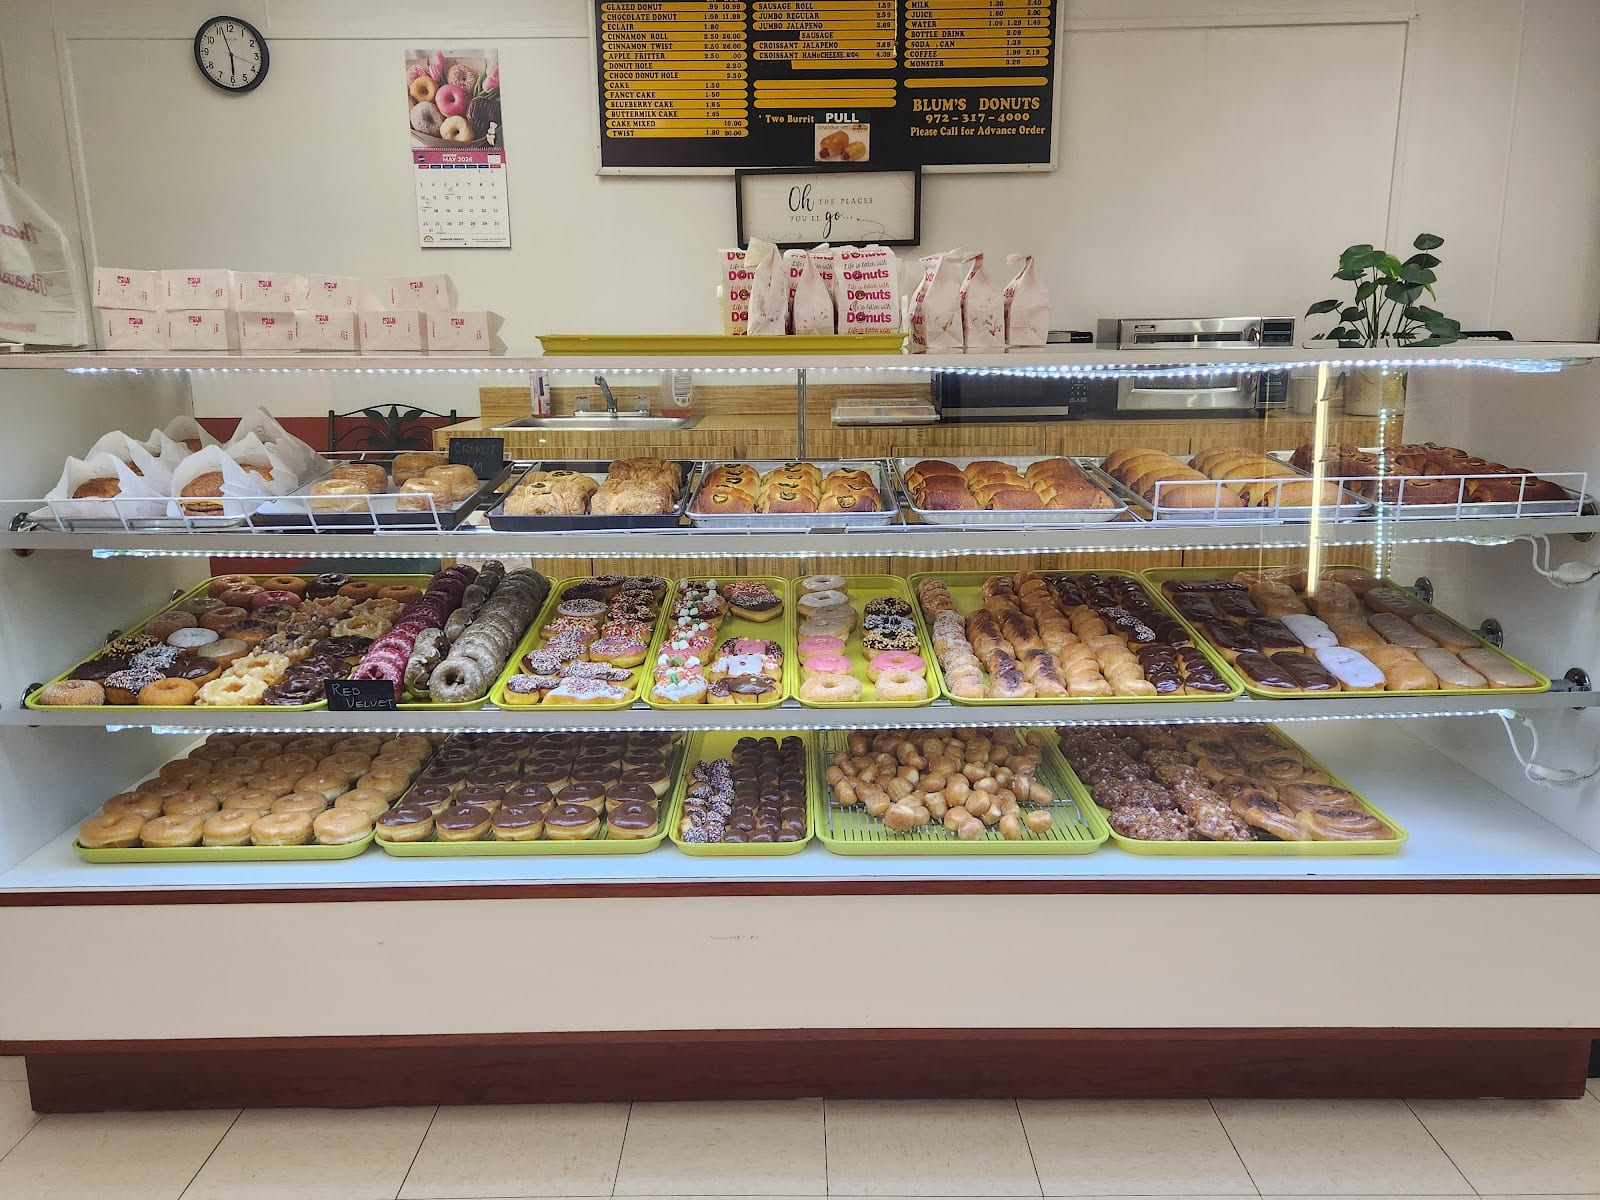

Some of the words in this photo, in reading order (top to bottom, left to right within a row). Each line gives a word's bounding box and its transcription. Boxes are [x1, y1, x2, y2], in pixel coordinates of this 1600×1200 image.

[606, 3, 635, 11] GLAZED
[637, 3, 663, 11] DONUT
[226, 24, 234, 33] 12
[607, 23, 634, 31] ECLAIR
[241, 29, 244, 38] 1
[207, 36, 215, 44] 10
[249, 40, 255, 48] 2
[204, 48, 209, 56] 9
[253, 52, 259, 61] 3
[208, 61, 214, 69] 8
[250, 65, 256, 73] 4
[218, 70, 223, 78] 7
[242, 74, 248, 82] 5
[230, 76, 236, 84] 6
[609, 91, 634, 99] FANCY
[912, 98, 967, 112] BLUM'S
[978, 97, 1040, 110] DONUTS
[765, 115, 785, 123] Two
[825, 112, 860, 123] PULL
[910, 126, 938, 137] Please
[939, 126, 958, 136] Call
[961, 126, 975, 136] for
[977, 126, 1017, 135] Advance
[1019, 125, 1046, 134] Order
[788, 184, 815, 212] Oh
[847, 289, 891, 300] Donuts
[847, 312, 892, 323] Donuts
[331, 683, 361, 696] RED
[346, 697, 393, 709] VELVET
